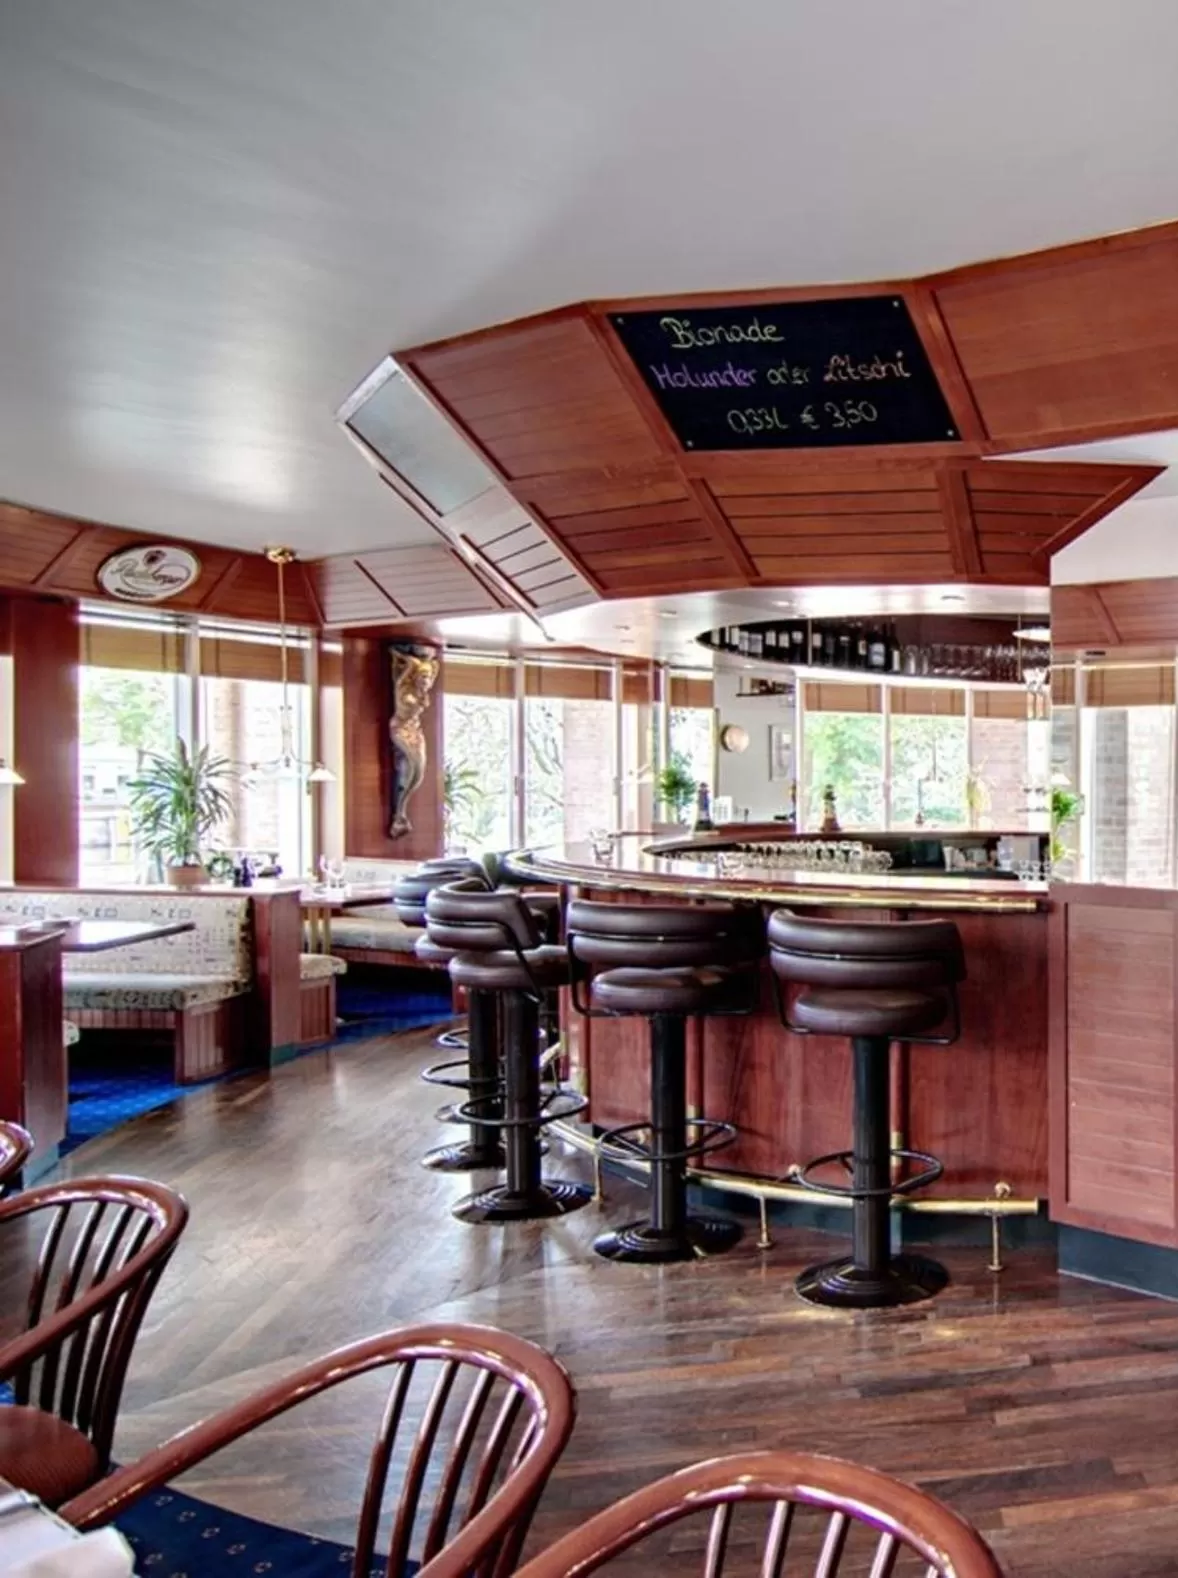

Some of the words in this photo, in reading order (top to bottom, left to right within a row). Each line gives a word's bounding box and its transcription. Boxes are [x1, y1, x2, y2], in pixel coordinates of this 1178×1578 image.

[660, 317, 785, 348] Bionade
[650, 361, 759, 389] Holunder
[823, 351, 911, 382] Litschi
[800, 405, 820, 430] €
[825, 400, 878, 428] 3,50
